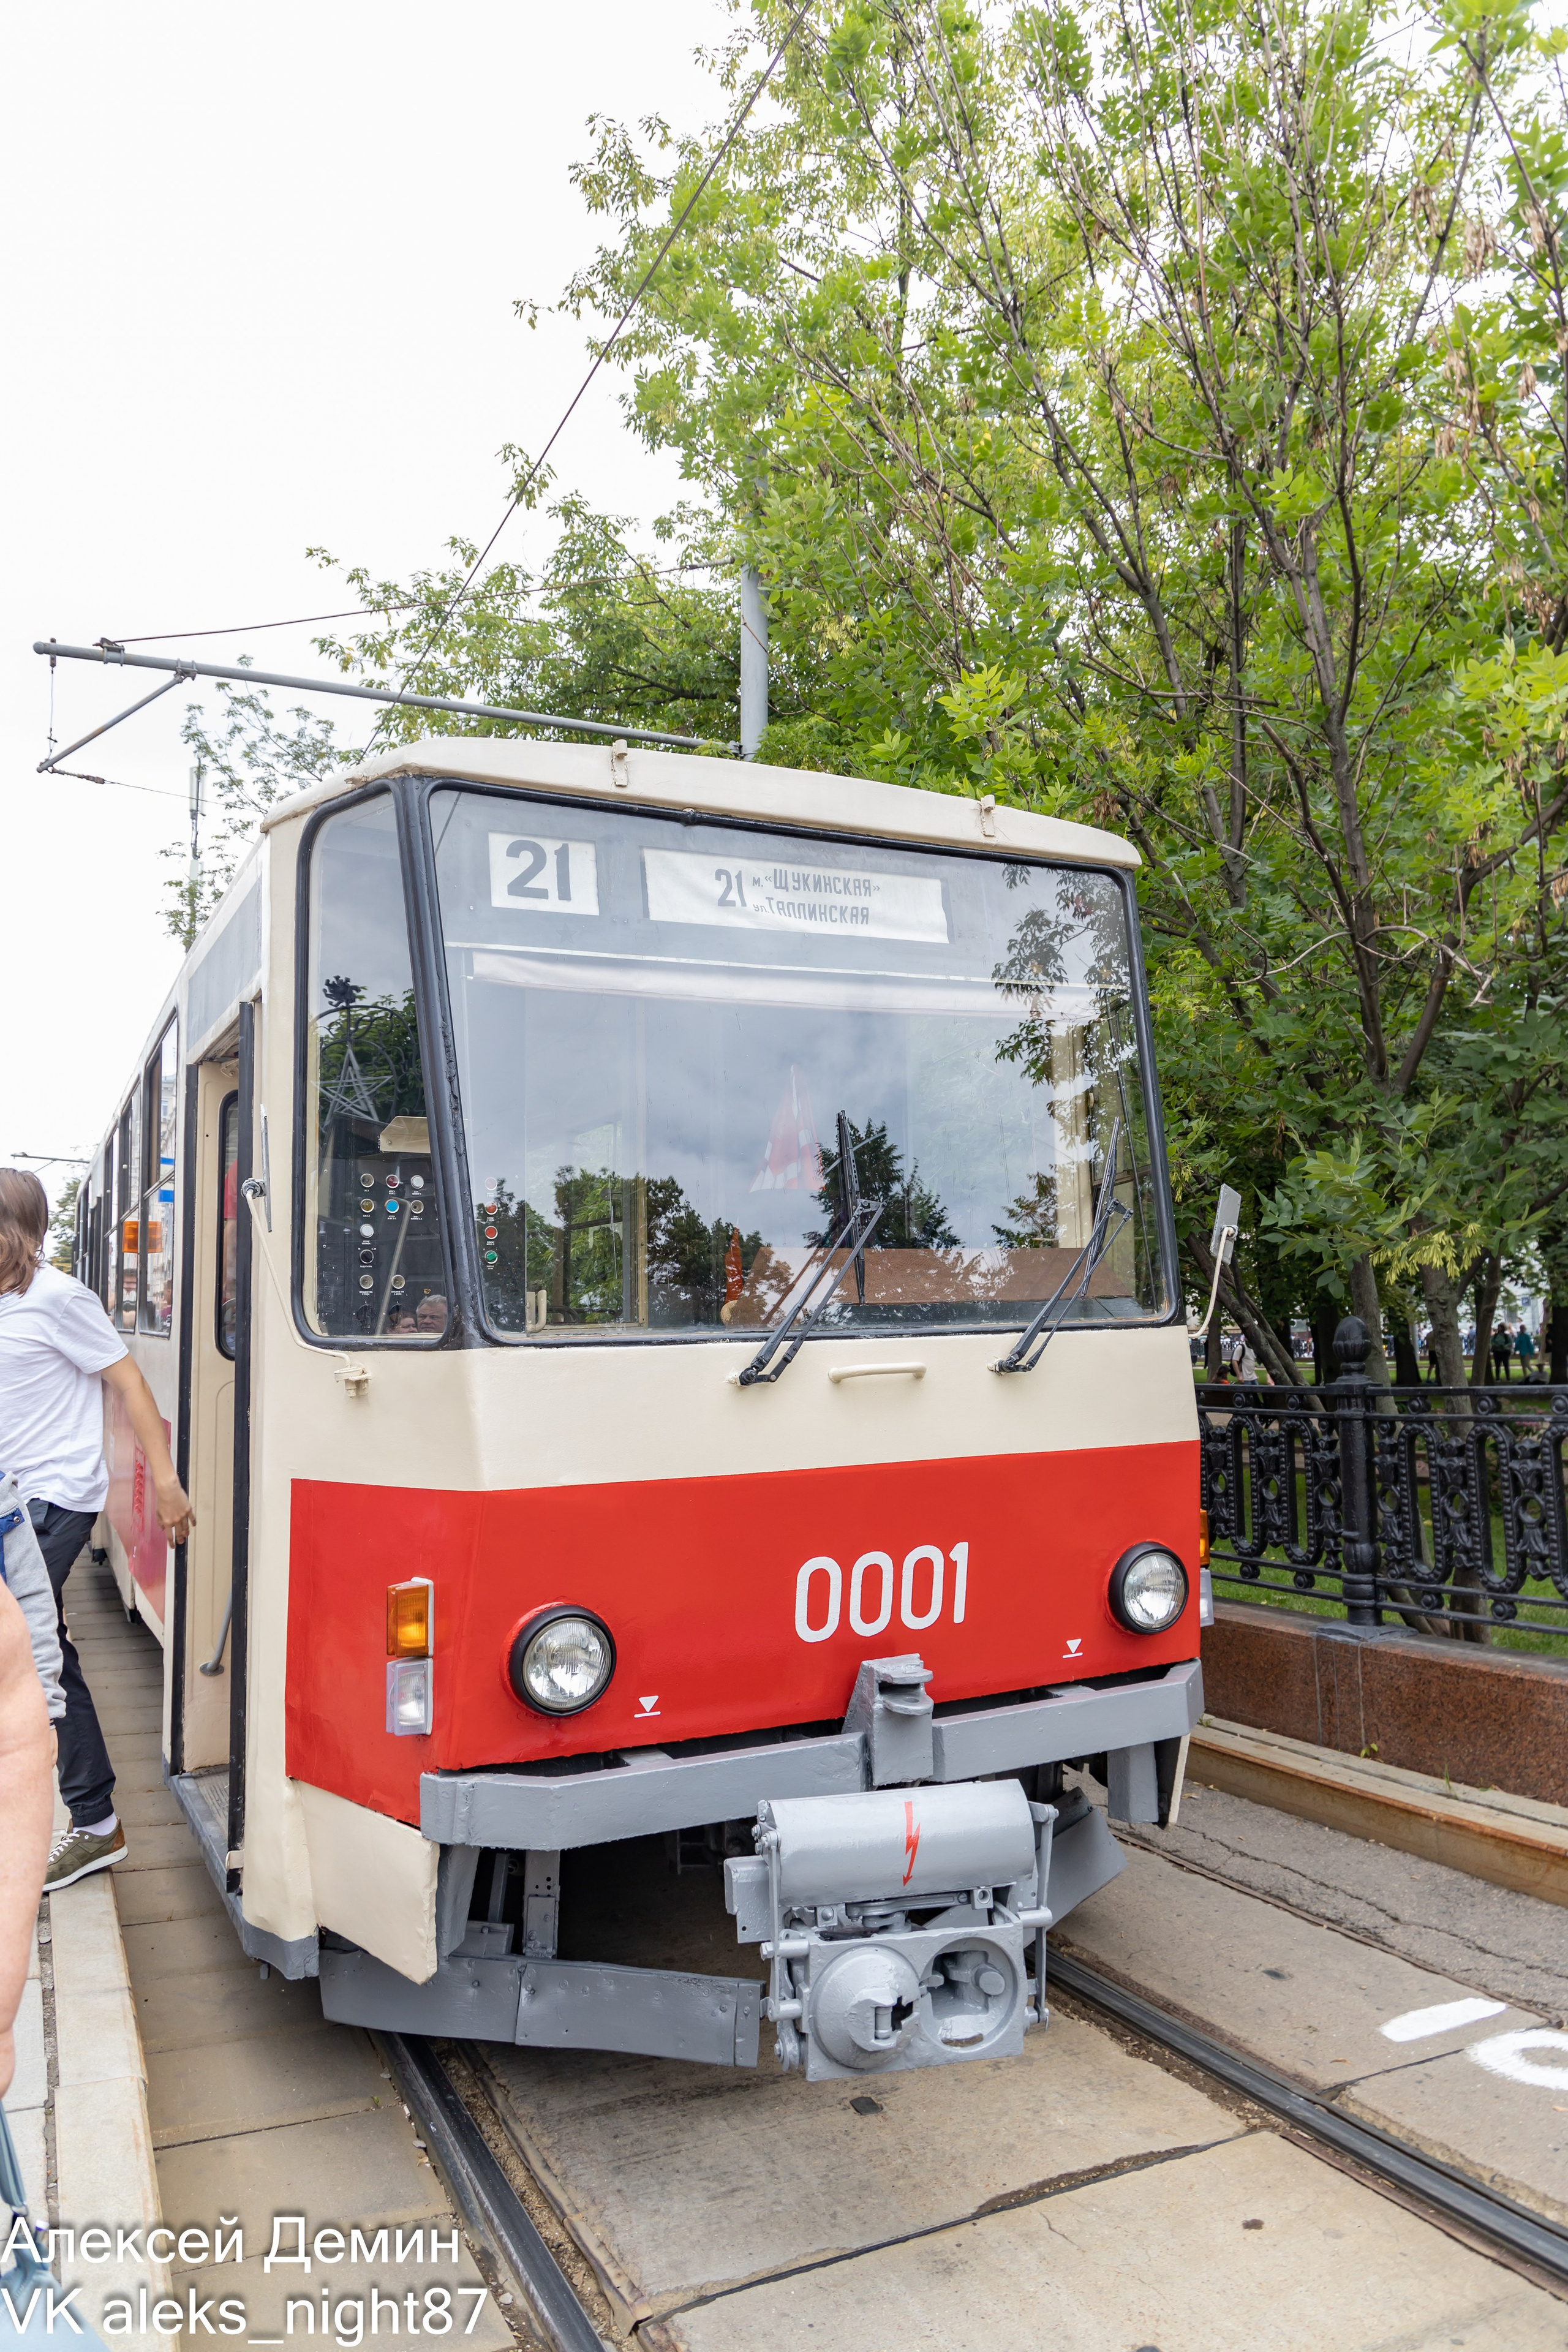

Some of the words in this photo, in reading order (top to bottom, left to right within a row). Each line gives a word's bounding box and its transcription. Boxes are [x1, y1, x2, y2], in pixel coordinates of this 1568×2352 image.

[505, 839, 571, 901] 21
[715, 869, 747, 907] 21
[794, 1542, 969, 1643] 0001
